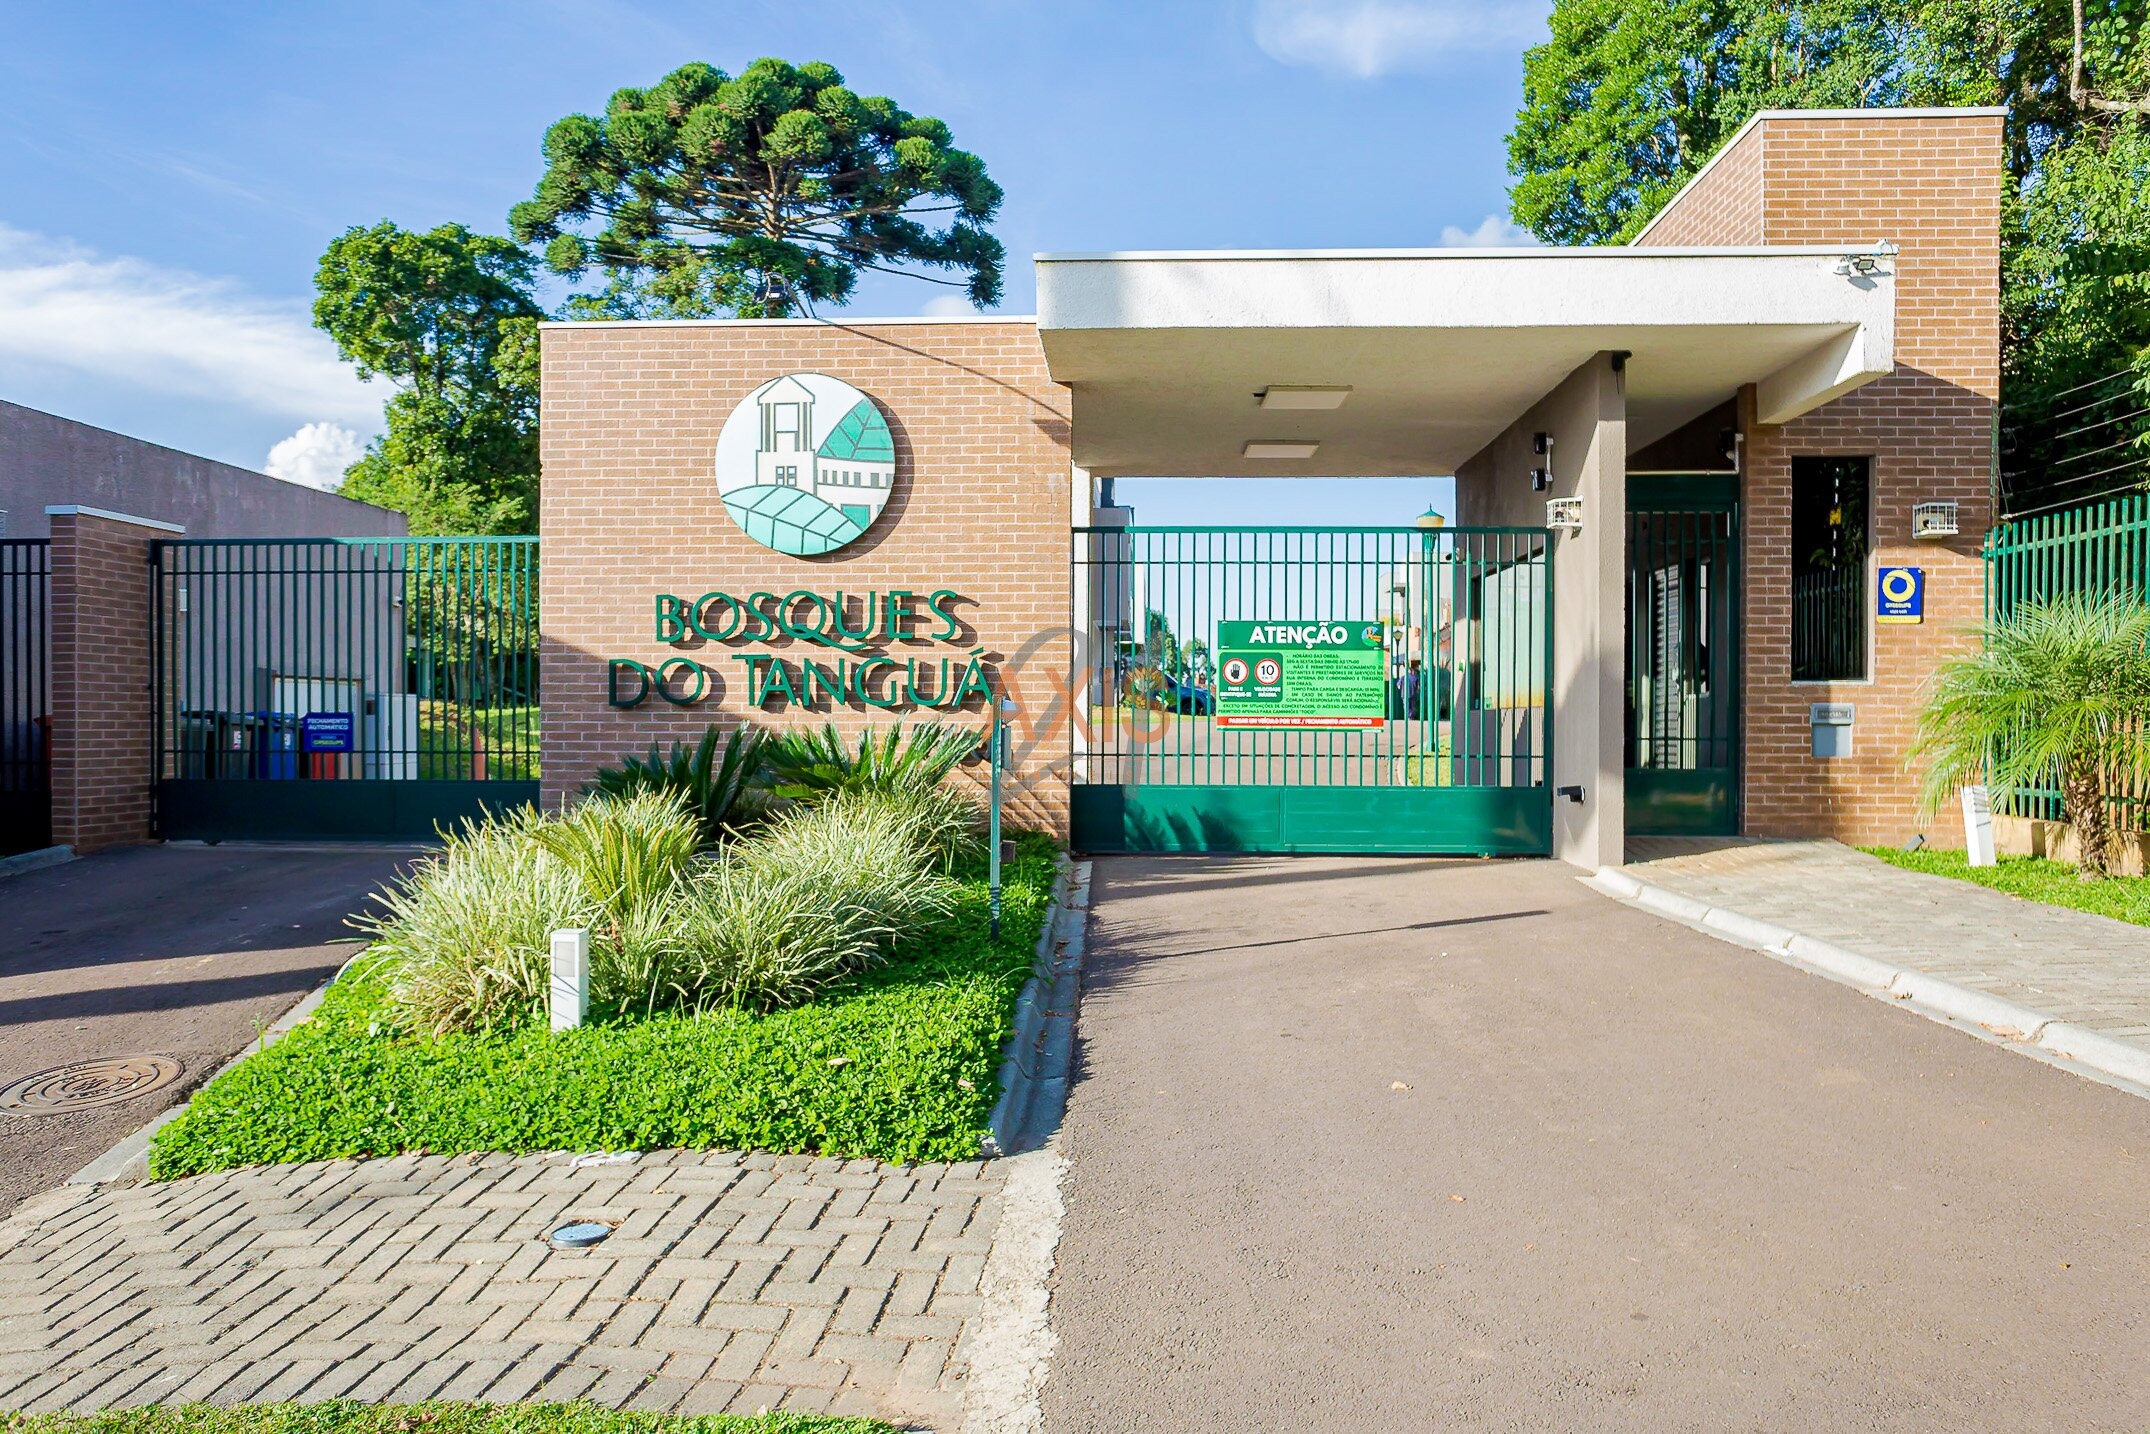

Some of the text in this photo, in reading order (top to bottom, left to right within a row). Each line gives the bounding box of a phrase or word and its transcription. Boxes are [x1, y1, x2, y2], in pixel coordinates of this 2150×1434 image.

[656, 590, 956, 651] BOSQUES
[1249, 621, 1348, 649] ATENÇÃO
[609, 647, 993, 709] DO TANGUÁ
[1261, 664, 1274, 675] 10
